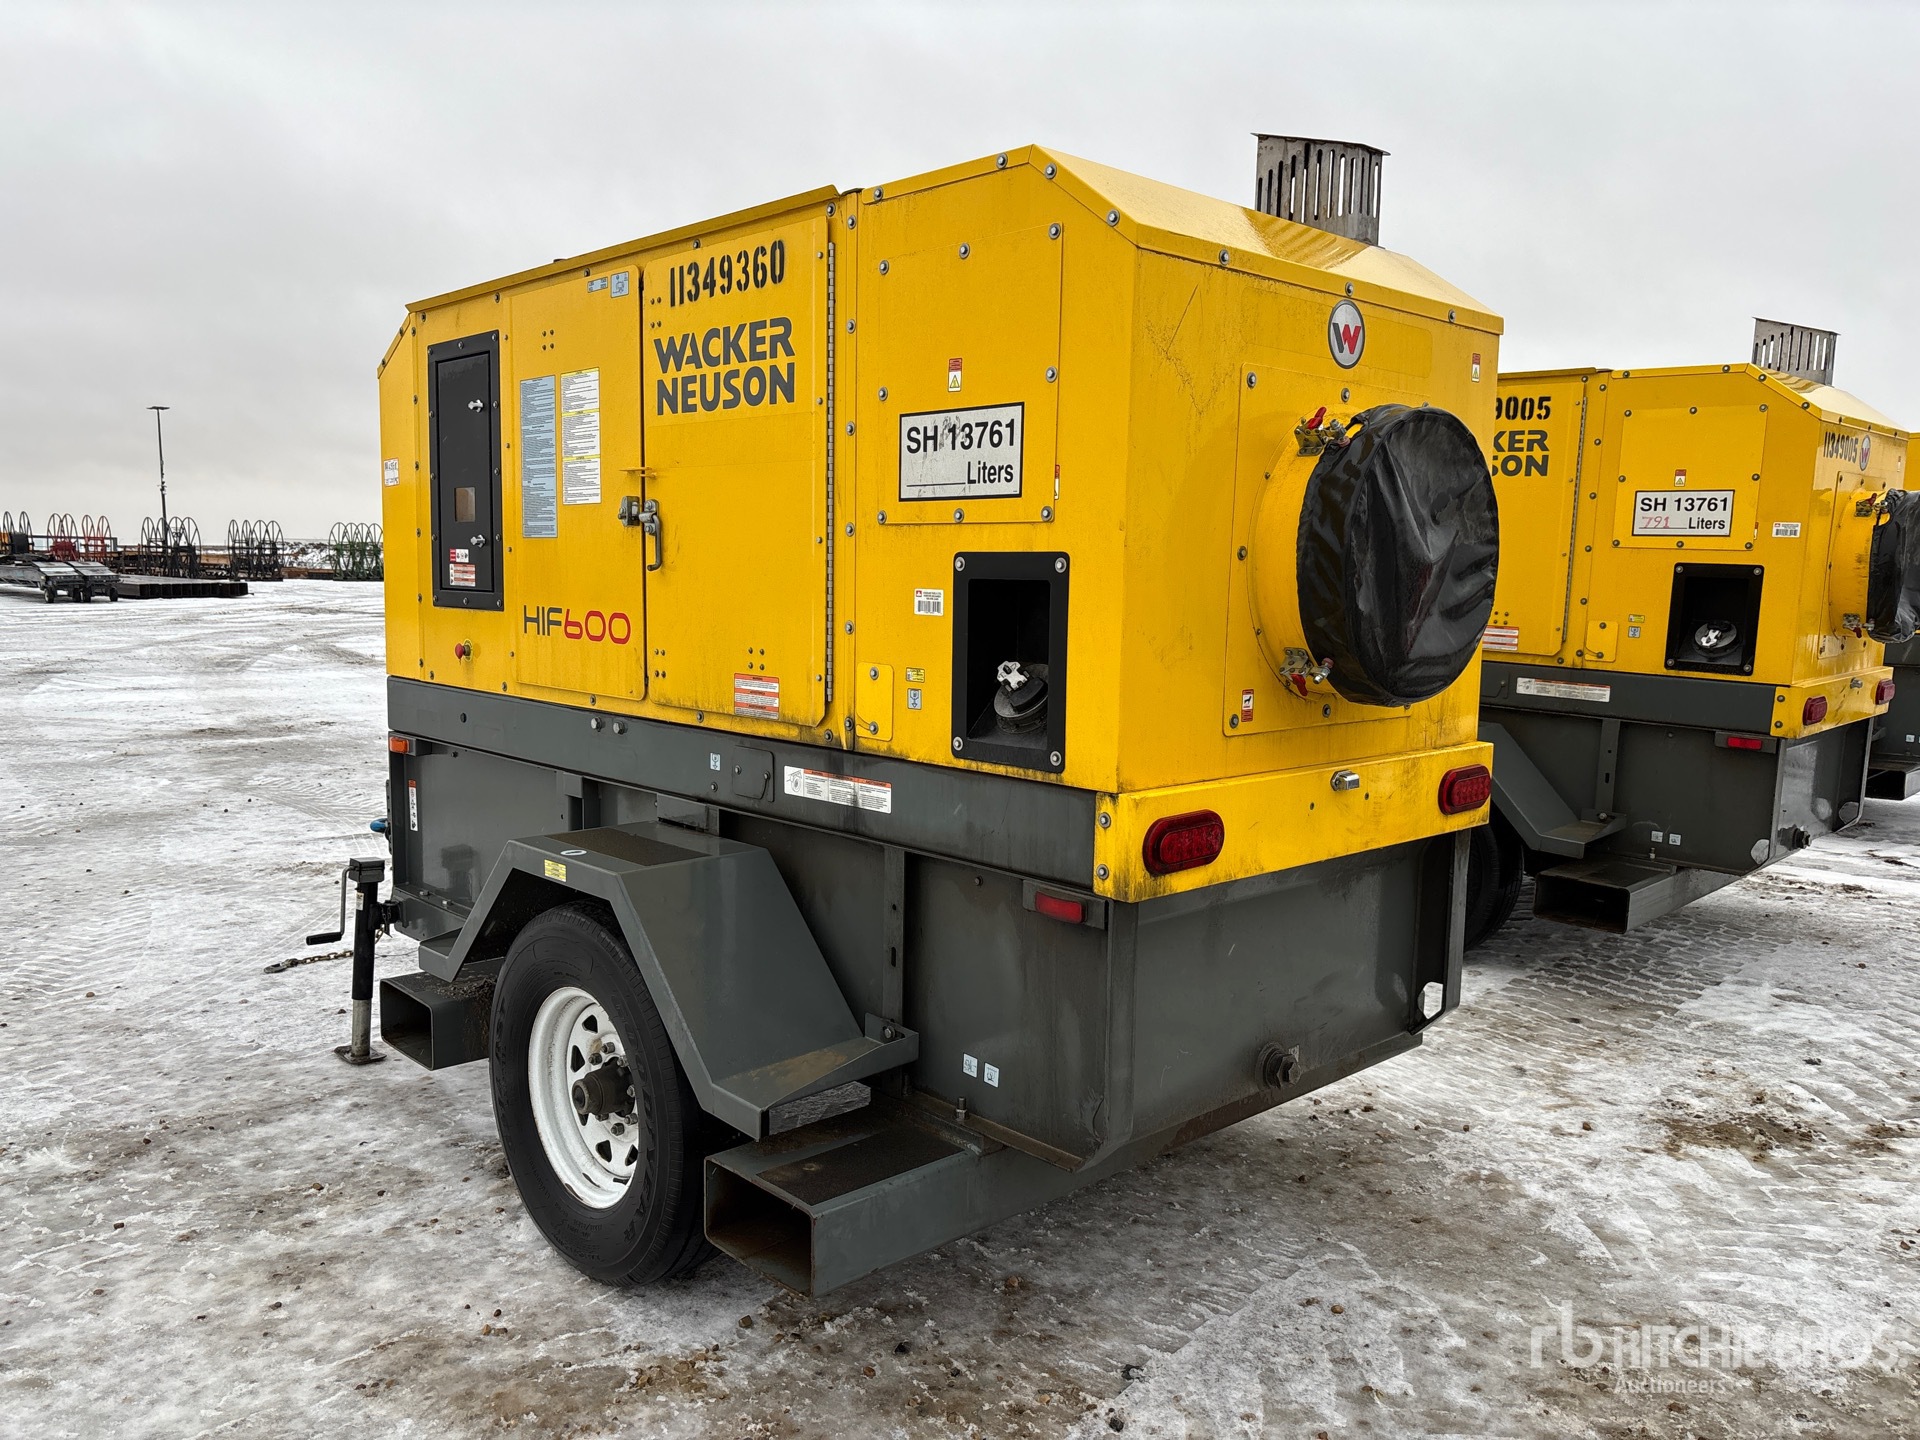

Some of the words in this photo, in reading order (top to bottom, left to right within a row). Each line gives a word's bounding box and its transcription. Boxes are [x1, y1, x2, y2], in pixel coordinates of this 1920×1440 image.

[669, 239, 785, 308] 11349360
[653, 316, 796, 374] WACKER
[657, 362, 795, 416] NEUSON
[906, 424, 938, 454] SH
[947, 418, 1015, 450] 13761
[1823, 431, 1859, 464] 11349005
[967, 461, 1014, 485] Liters
[1640, 497, 1667, 512] SH
[1674, 497, 1728, 511] 13761
[1642, 515, 1670, 529] 791
[1688, 517, 1726, 529] Liters
[523, 605, 631, 645] HIF600
